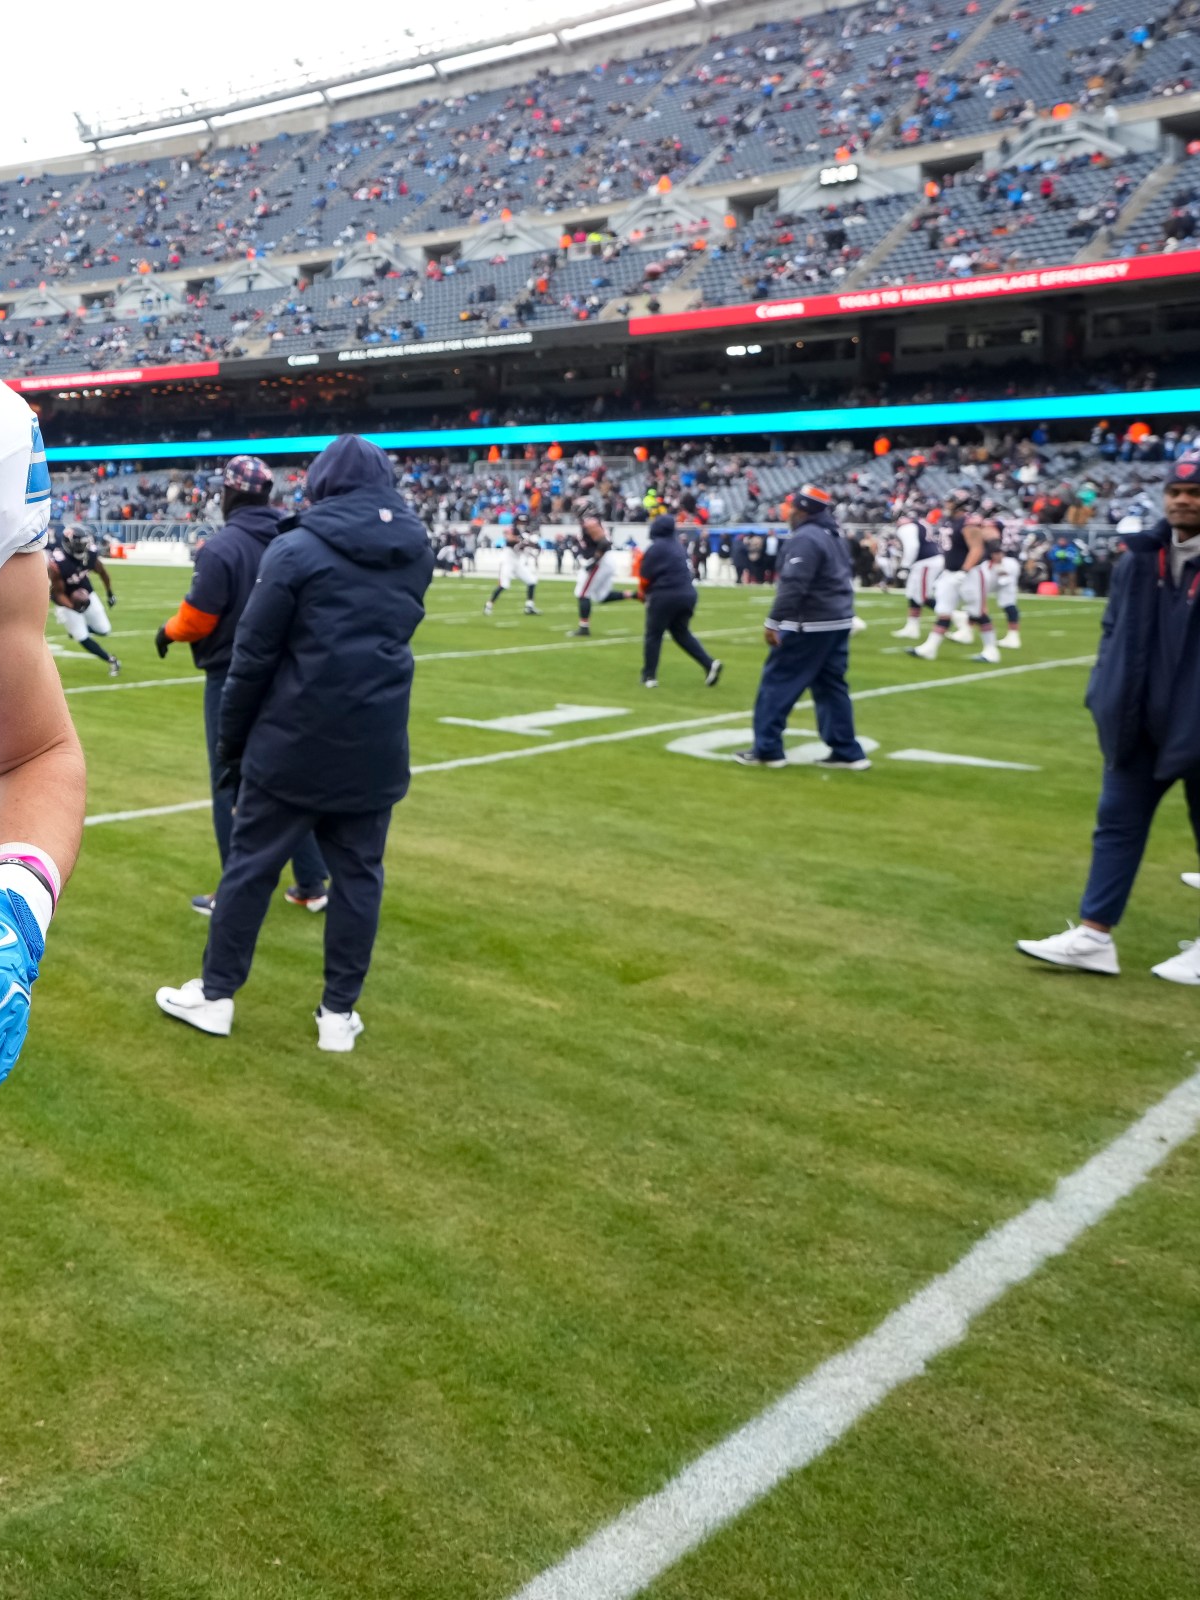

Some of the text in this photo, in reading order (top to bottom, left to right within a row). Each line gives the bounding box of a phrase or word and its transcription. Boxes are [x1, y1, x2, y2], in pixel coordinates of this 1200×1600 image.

[755, 263, 1128, 319] Canon TOOLS TO TACKLE WORKPLACE EFFICIENCY
